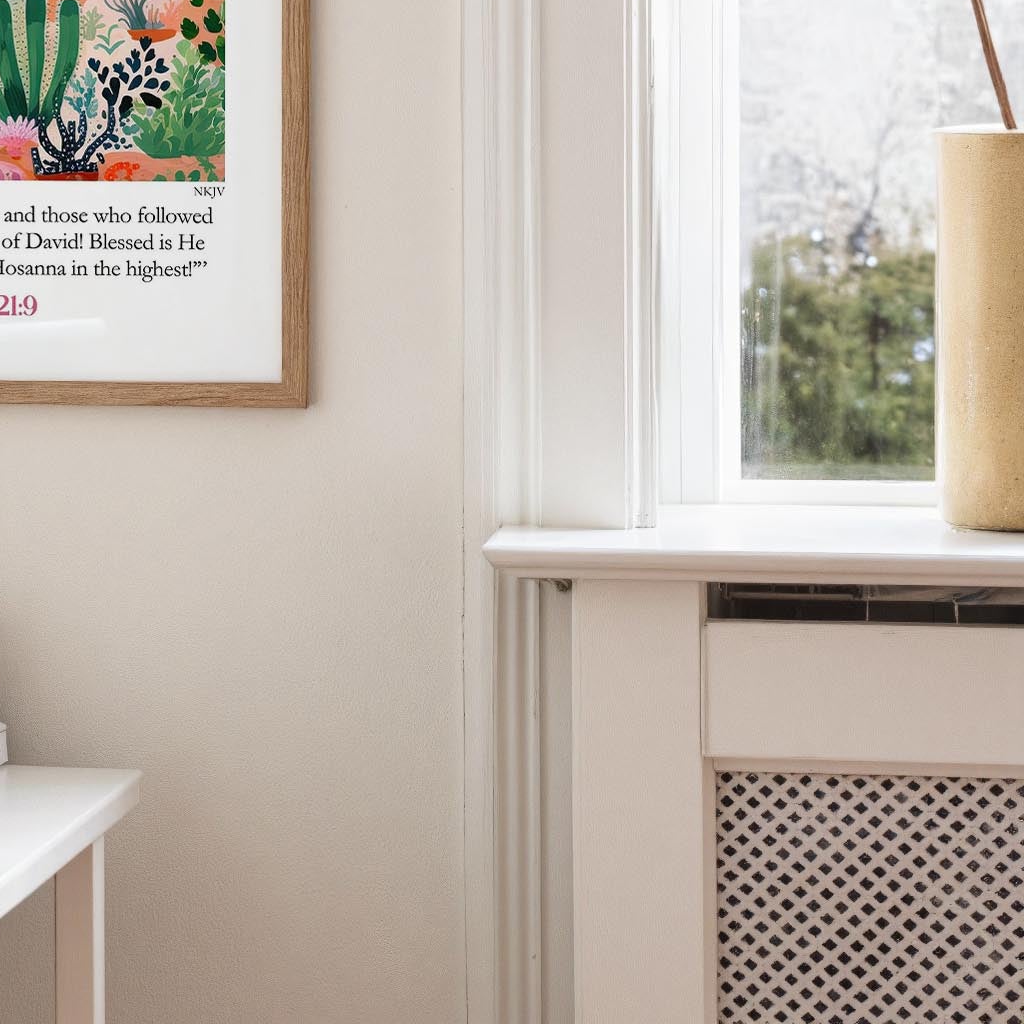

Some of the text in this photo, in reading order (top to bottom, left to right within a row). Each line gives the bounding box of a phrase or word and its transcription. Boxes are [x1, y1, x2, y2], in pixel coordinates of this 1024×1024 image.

[193, 186, 225, 198] NKJV
[4, 205, 36, 223] and
[41, 206, 88, 223] those
[93, 206, 131, 223] who
[138, 206, 213, 224] followed
[2, 232, 23, 249] of
[25, 233, 83, 249] David!
[89, 233, 154, 250] Blessed
[159, 234, 172, 250] is
[178, 234, 205, 250] He
[71, 260, 88, 276] in
[94, 260, 120, 276] the
